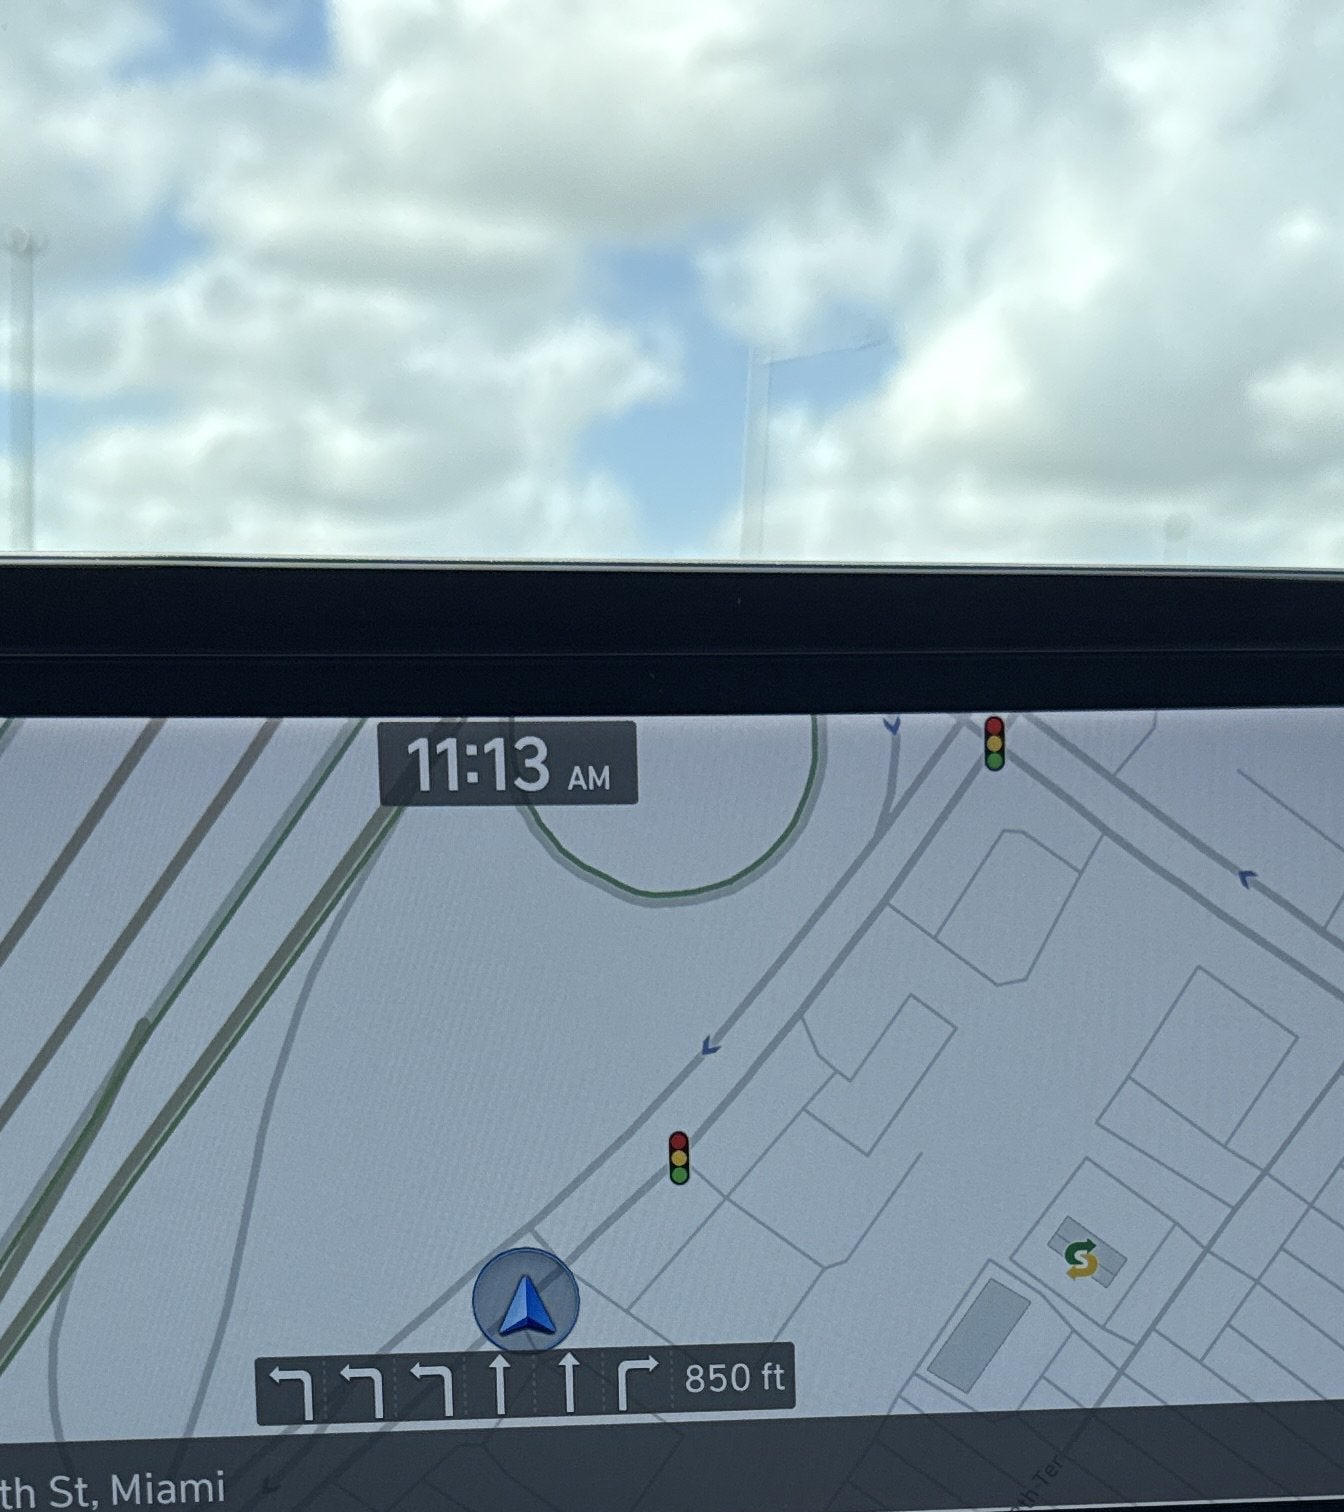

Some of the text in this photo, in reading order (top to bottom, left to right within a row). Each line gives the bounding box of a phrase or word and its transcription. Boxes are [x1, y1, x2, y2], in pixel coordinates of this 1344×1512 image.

[406, 735, 612, 794] 11:13 AM
[684, 1360, 786, 1394] 850 ft
[110, 1471, 227, 1508] Miami
